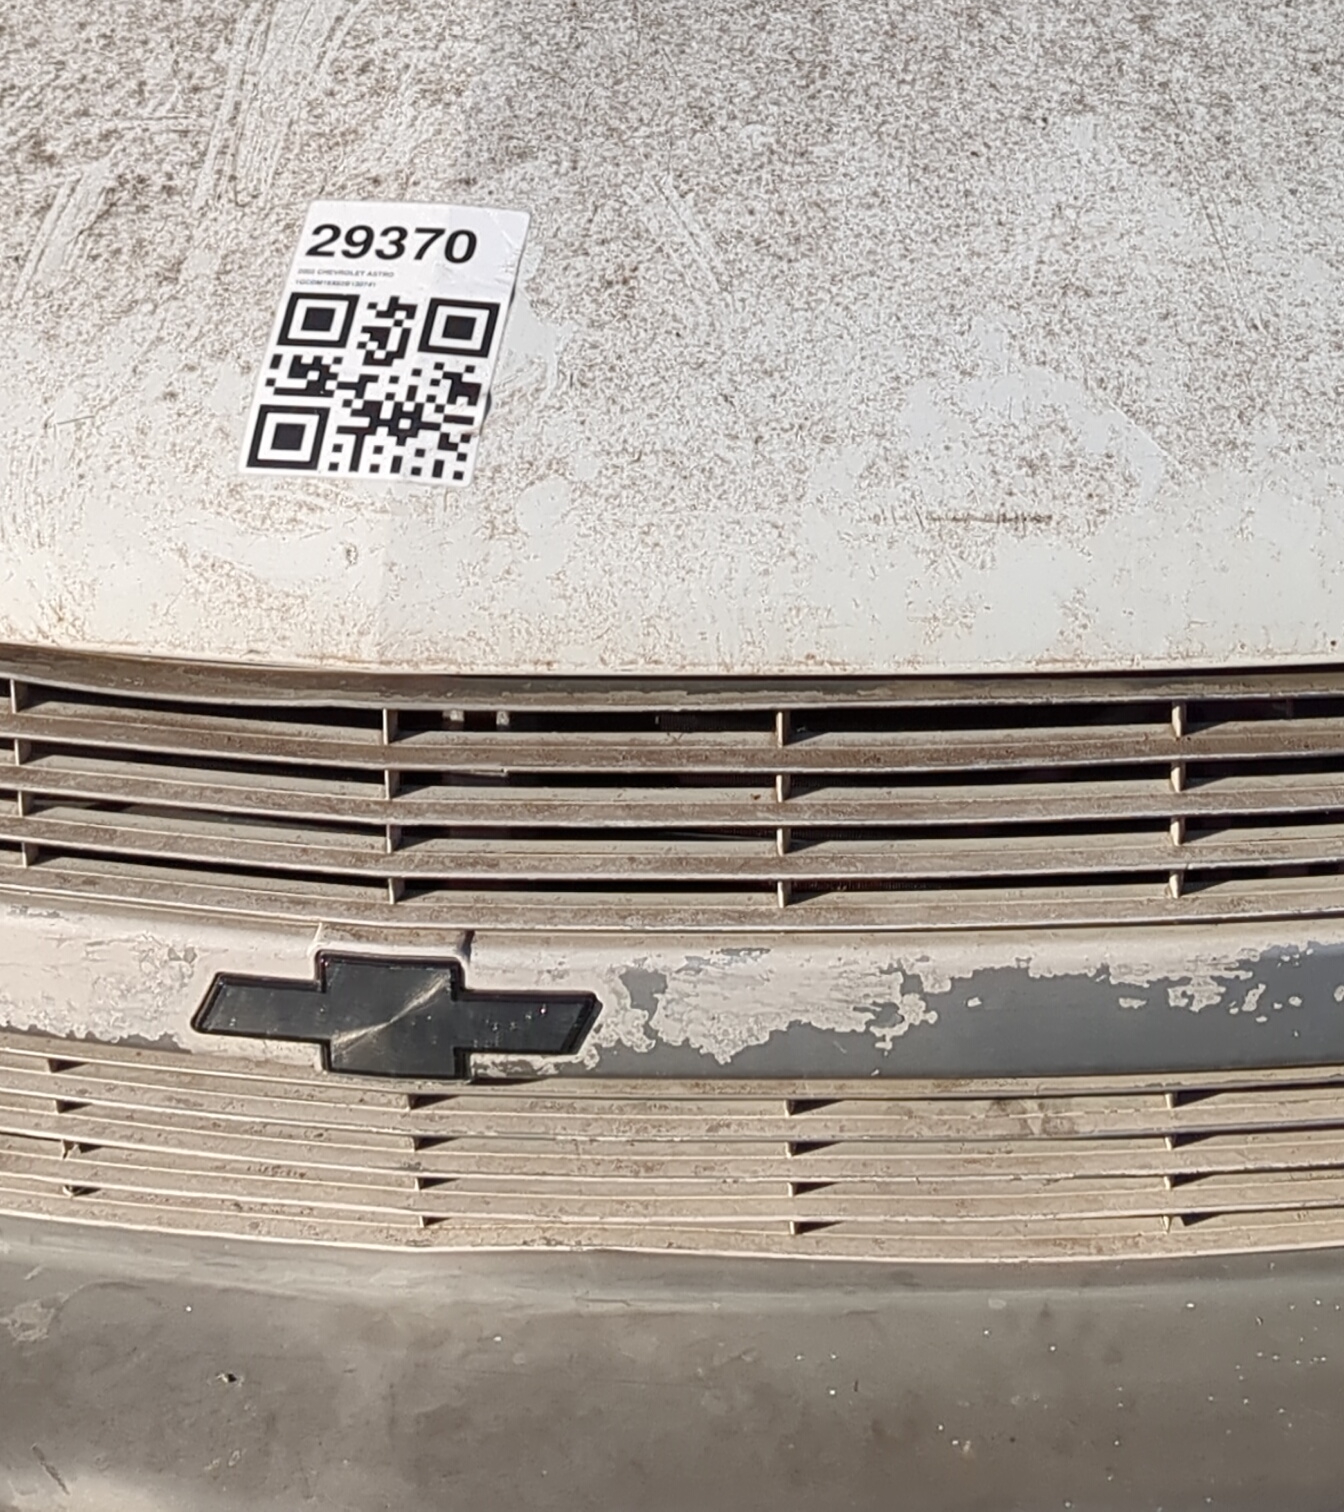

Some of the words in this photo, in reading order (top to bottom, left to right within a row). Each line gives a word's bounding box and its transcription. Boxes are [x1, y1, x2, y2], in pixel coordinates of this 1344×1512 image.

[305, 223, 478, 264] 29370
[316, 268, 366, 277] CHEVROLET
[366, 270, 395, 278] ASTRO
